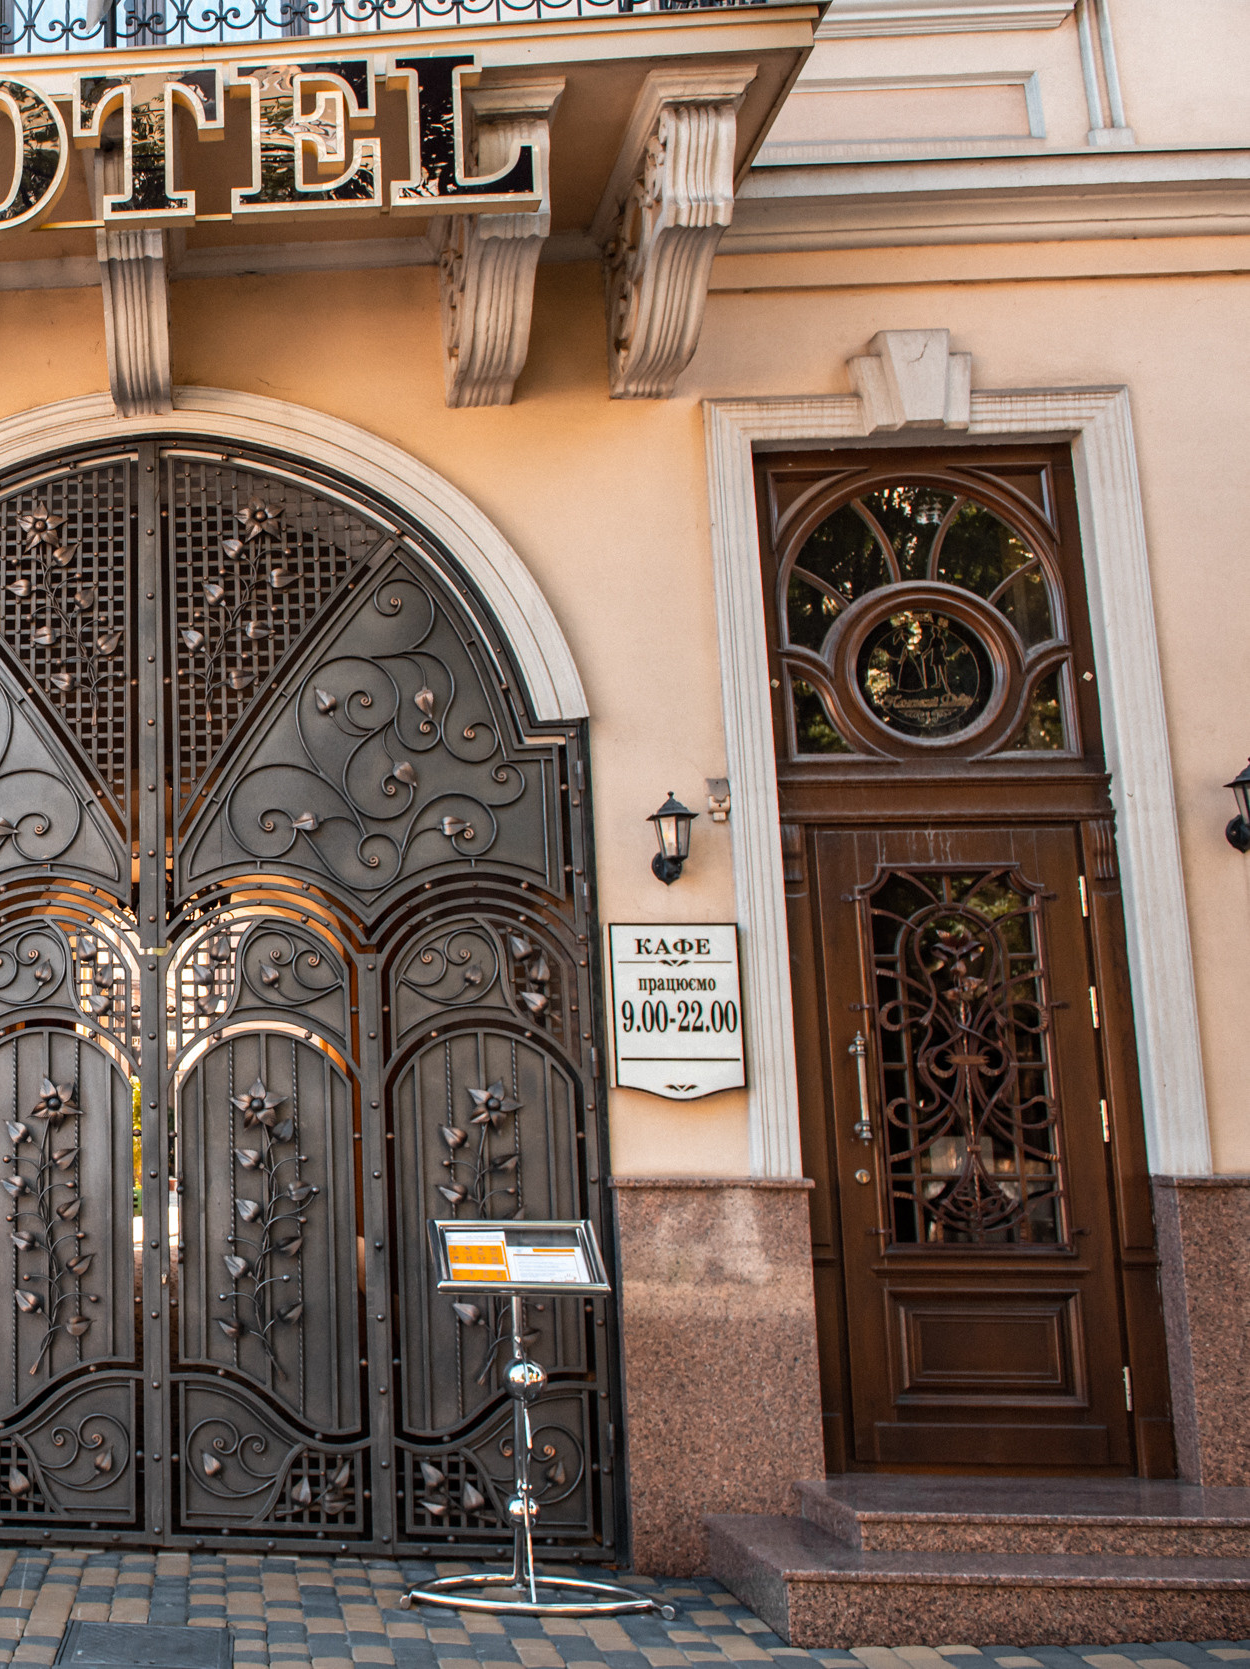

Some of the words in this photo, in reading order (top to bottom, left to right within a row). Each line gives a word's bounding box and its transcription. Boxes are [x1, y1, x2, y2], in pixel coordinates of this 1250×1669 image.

[635, 938, 711, 955] КАФЕ
[638, 977, 717, 996] працюємо
[621, 1000, 738, 1033] 9.00-22.00
